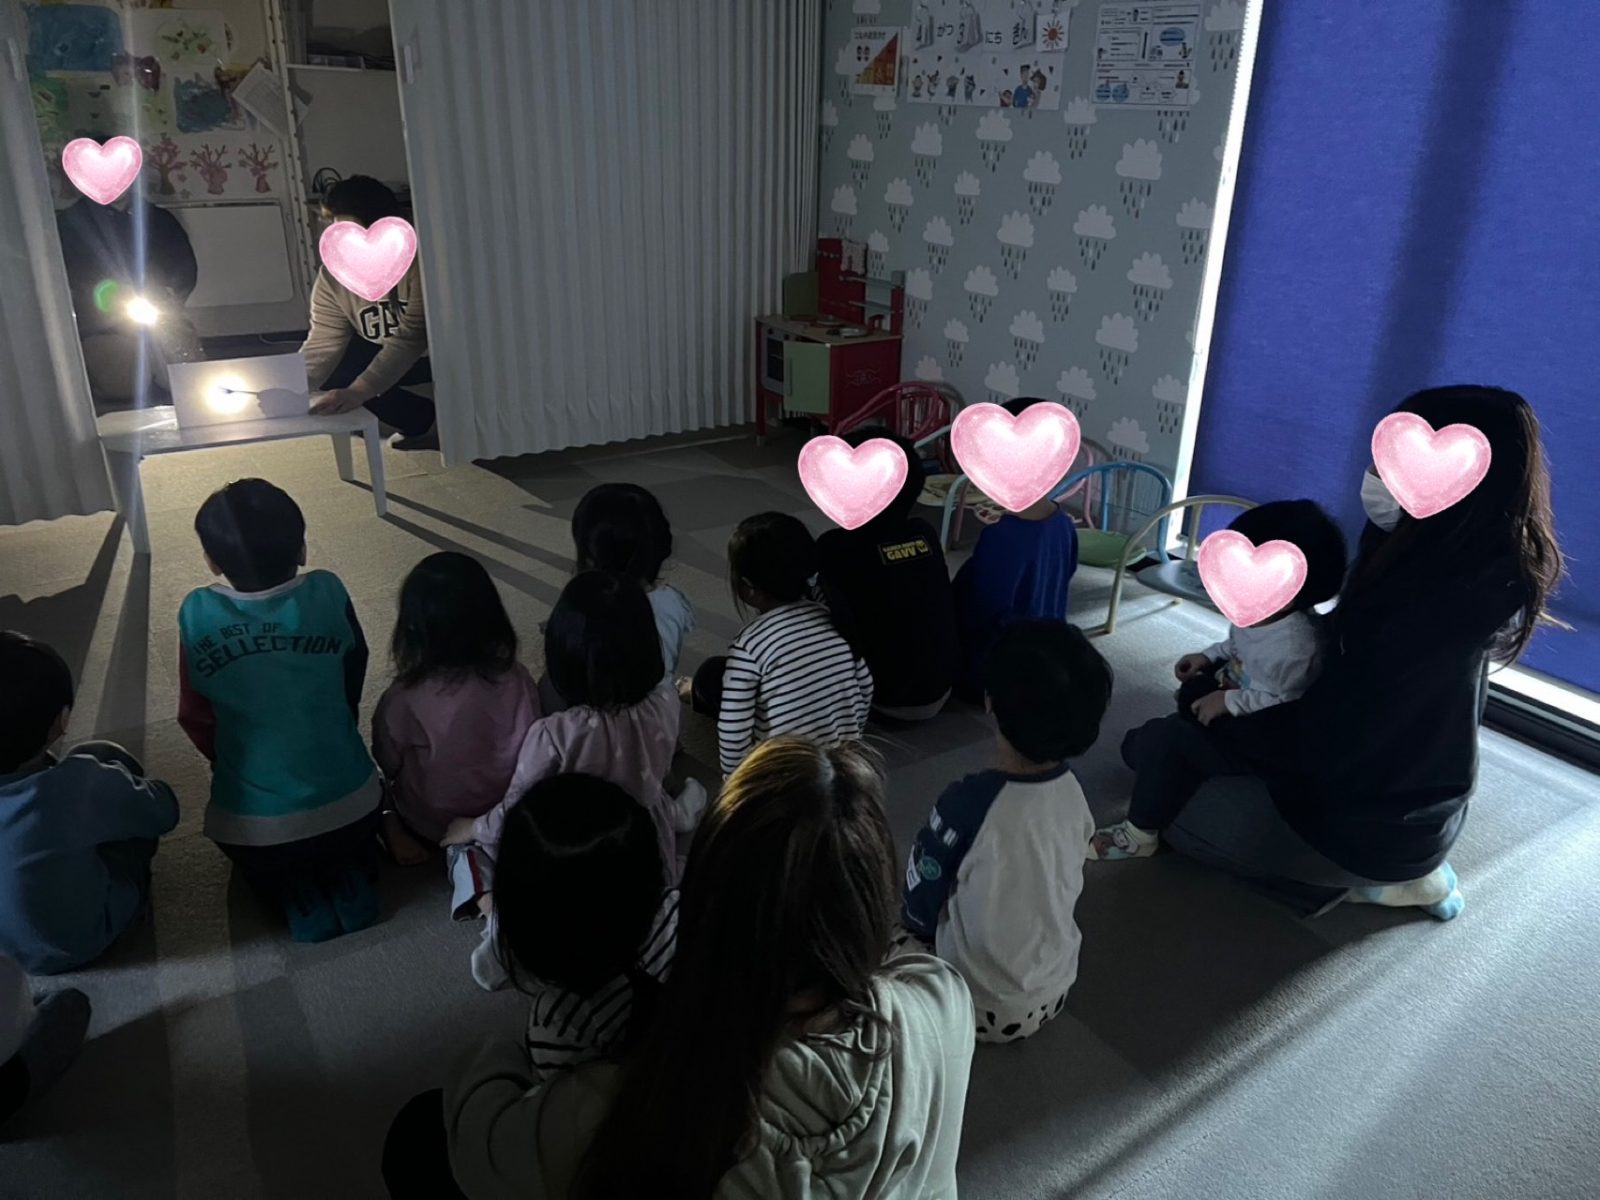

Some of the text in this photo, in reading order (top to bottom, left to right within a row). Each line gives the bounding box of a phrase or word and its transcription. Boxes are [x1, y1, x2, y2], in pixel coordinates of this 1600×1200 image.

[985, 31, 1002, 44] にち
[194, 622, 281, 654] THE BEST OF
[196, 636, 343, 678] SELLECTION
